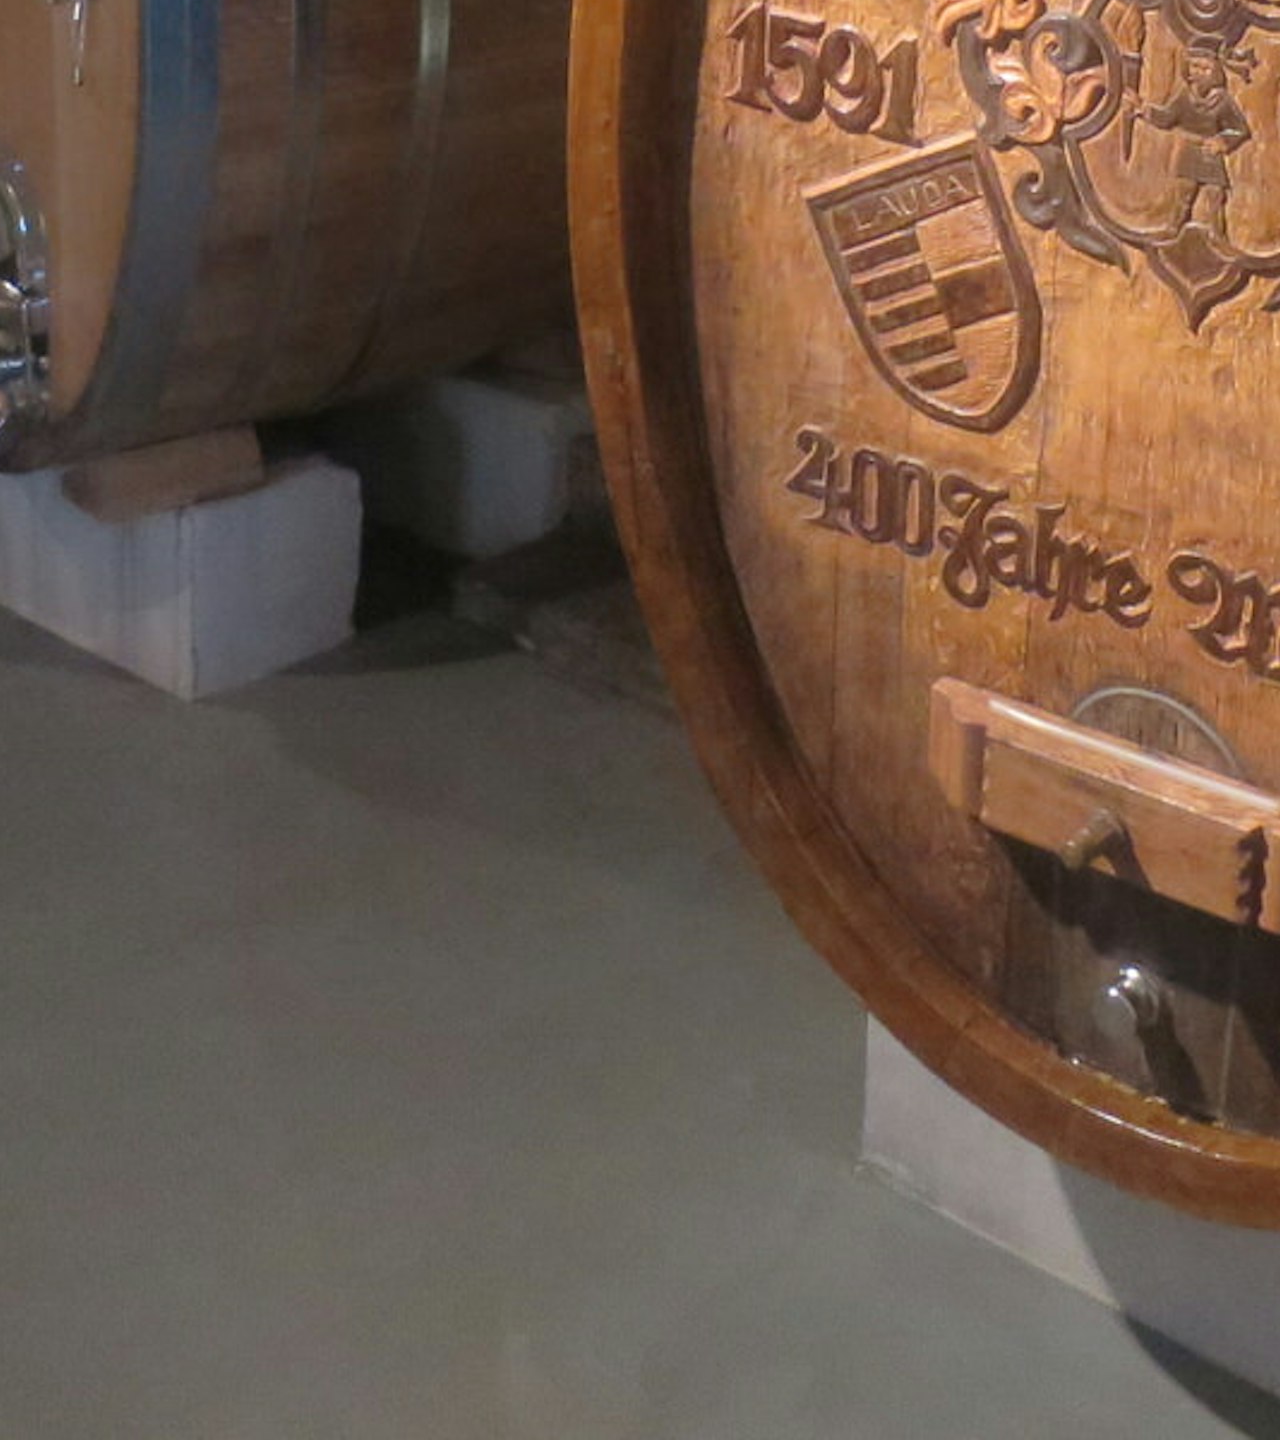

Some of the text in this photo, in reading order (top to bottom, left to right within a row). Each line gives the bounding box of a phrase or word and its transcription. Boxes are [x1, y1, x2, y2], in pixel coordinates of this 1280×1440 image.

[724, 2, 924, 148] 1591
[851, 174, 969, 232] LAUDA
[785, 425, 935, 558] 400
[938, 470, 1153, 628] Jahre
